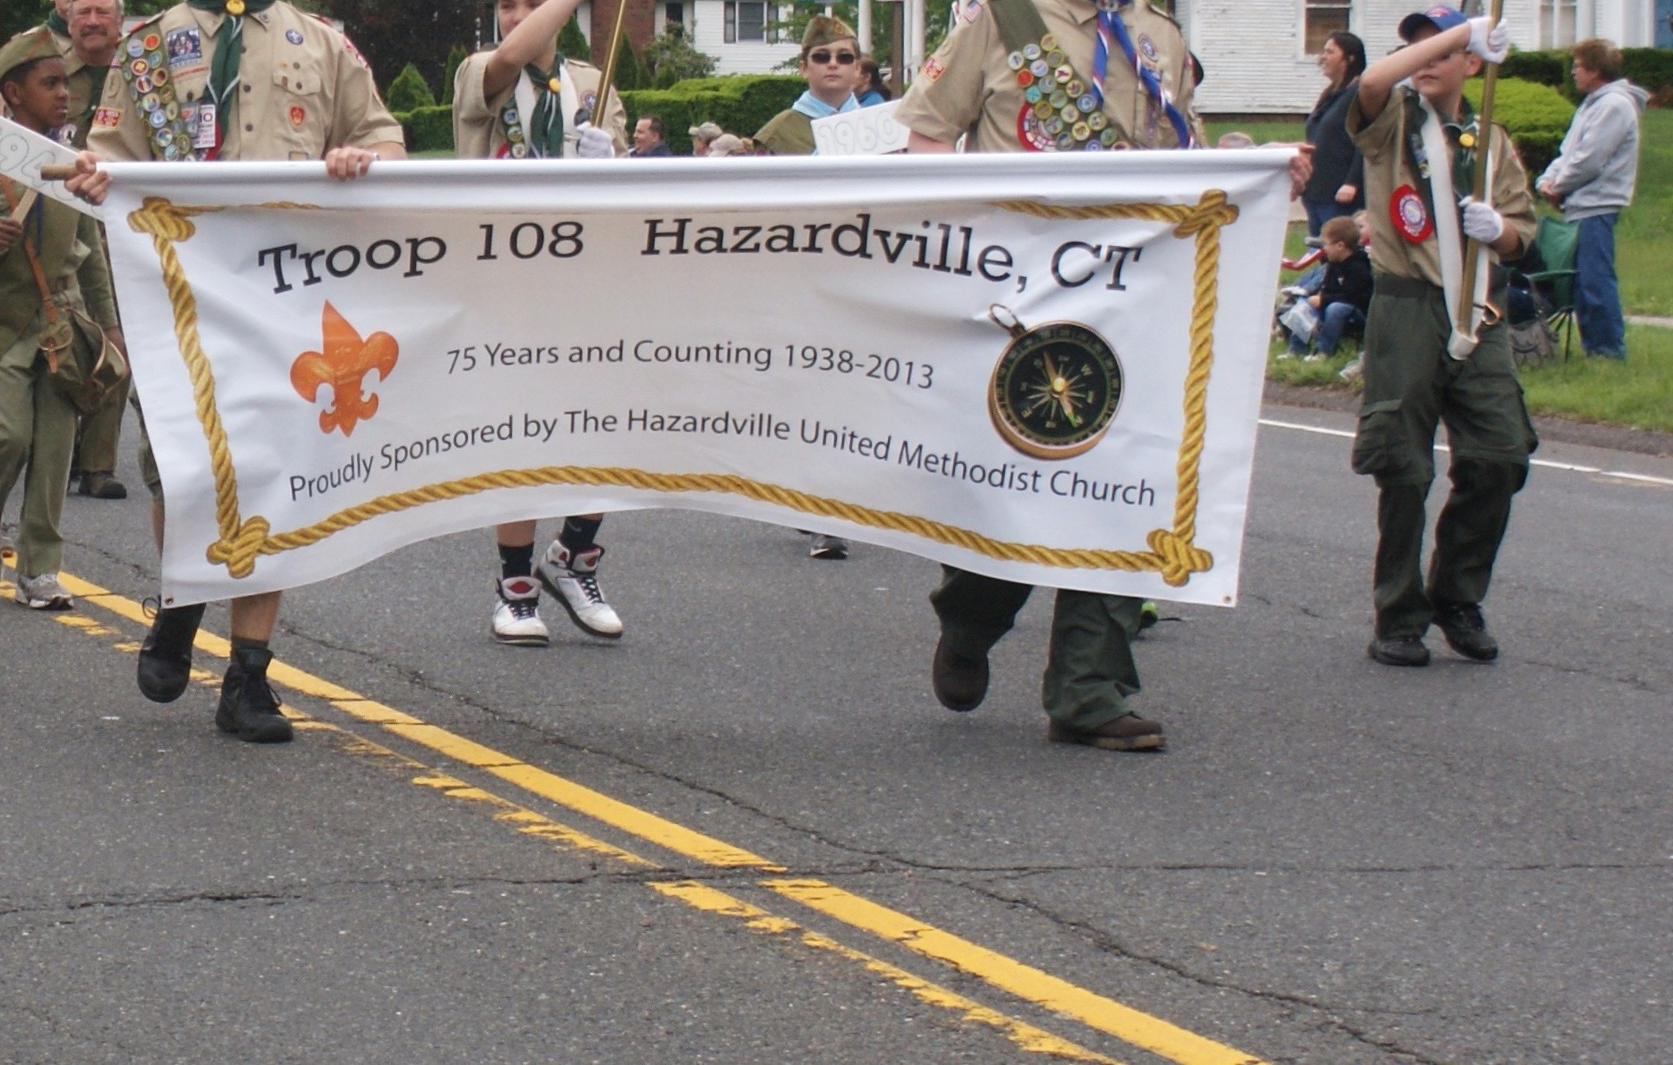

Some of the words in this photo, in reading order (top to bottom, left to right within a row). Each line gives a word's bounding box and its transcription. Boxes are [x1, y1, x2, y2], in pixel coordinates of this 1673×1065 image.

[817, 110, 900, 155] 1960
[258, 236, 447, 295] Troop
[476, 221, 584, 260] 108
[640, 213, 1028, 293] Hazardville,
[1051, 240, 1144, 291] CT
[447, 346, 477, 374] 75
[484, 343, 559, 367] Years
[568, 340, 624, 363] and
[633, 340, 772, 372] Counting
[784, 344, 934, 389] 1938-2013
[290, 453, 374, 501] Proudly
[380, 415, 513, 471] Sponsored
[523, 413, 558, 442] by
[564, 409, 617, 433] The
[628, 409, 790, 441] Hazardville
[800, 419, 892, 461] United
[897, 440, 1042, 493] Methodist
[1050, 470, 1155, 506] Church
